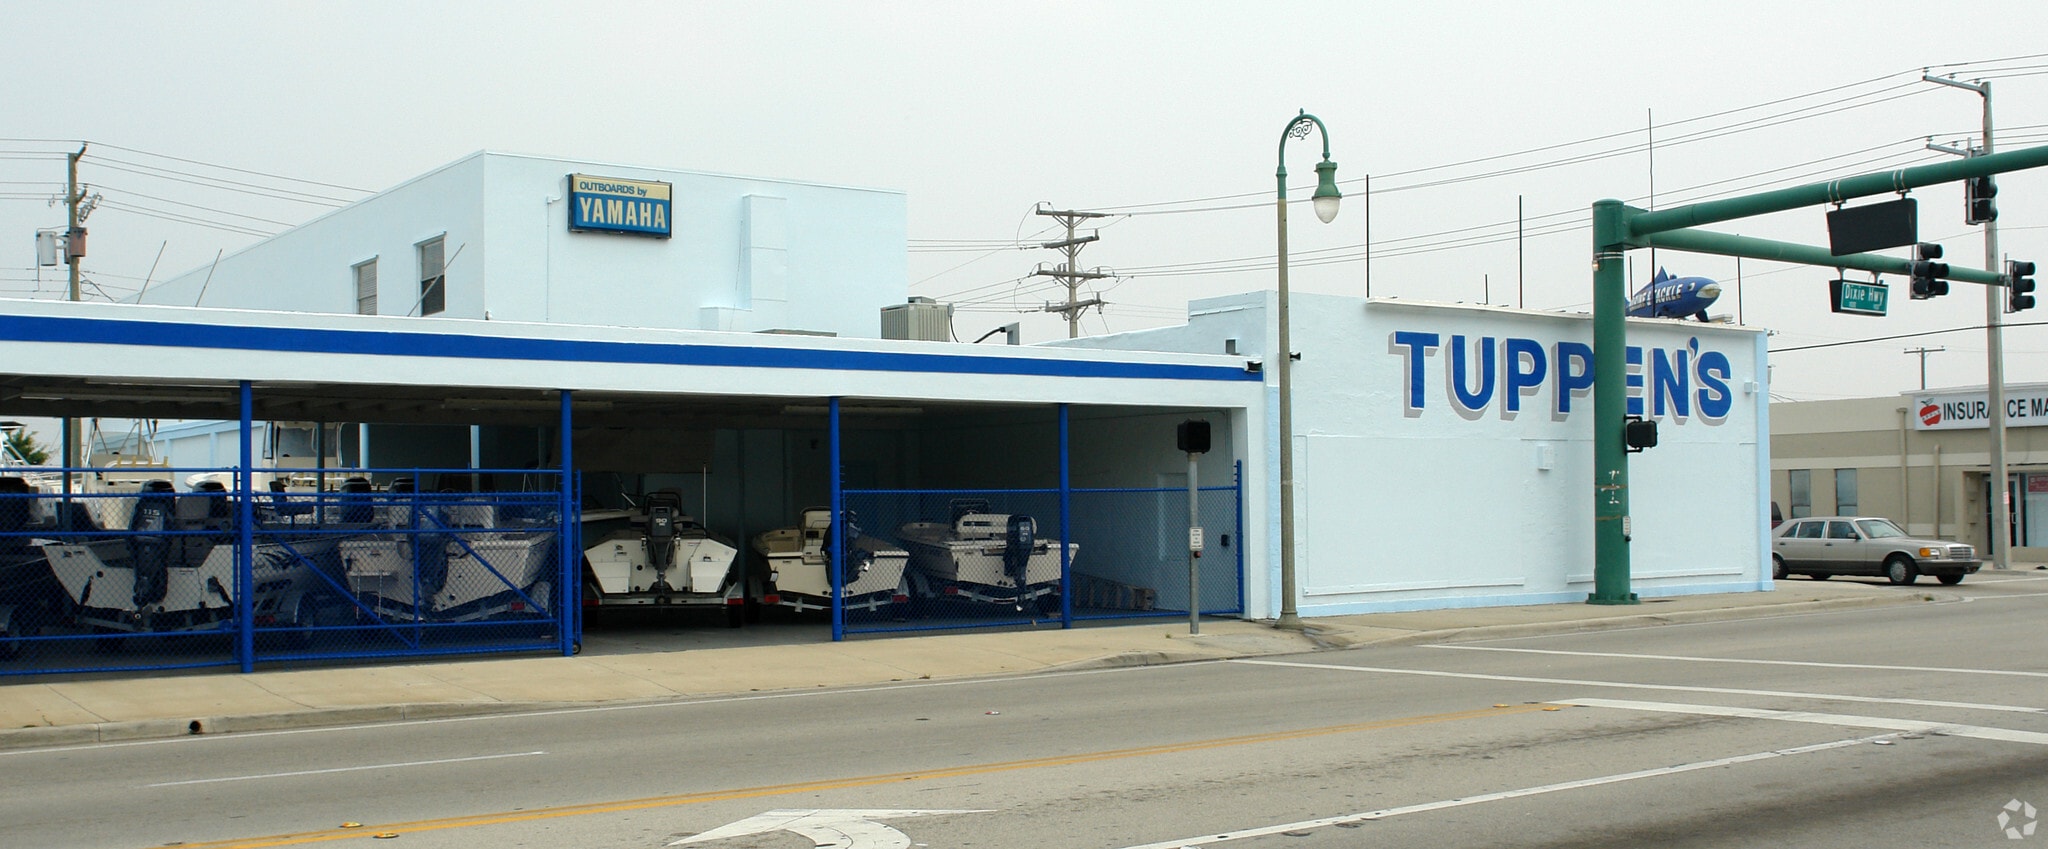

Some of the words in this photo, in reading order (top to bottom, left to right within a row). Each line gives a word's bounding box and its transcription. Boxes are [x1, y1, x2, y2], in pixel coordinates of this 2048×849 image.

[580, 182, 634, 194] OUTBOARDS
[637, 186, 647, 197] by
[579, 197, 666, 229] YAMAHA
[1654, 283, 1684, 304] ACKLE
[1845, 284, 1865, 301] Dixie
[1868, 287, 1884, 307] Hwy
[1943, 399, 2026, 420] INSURCE
